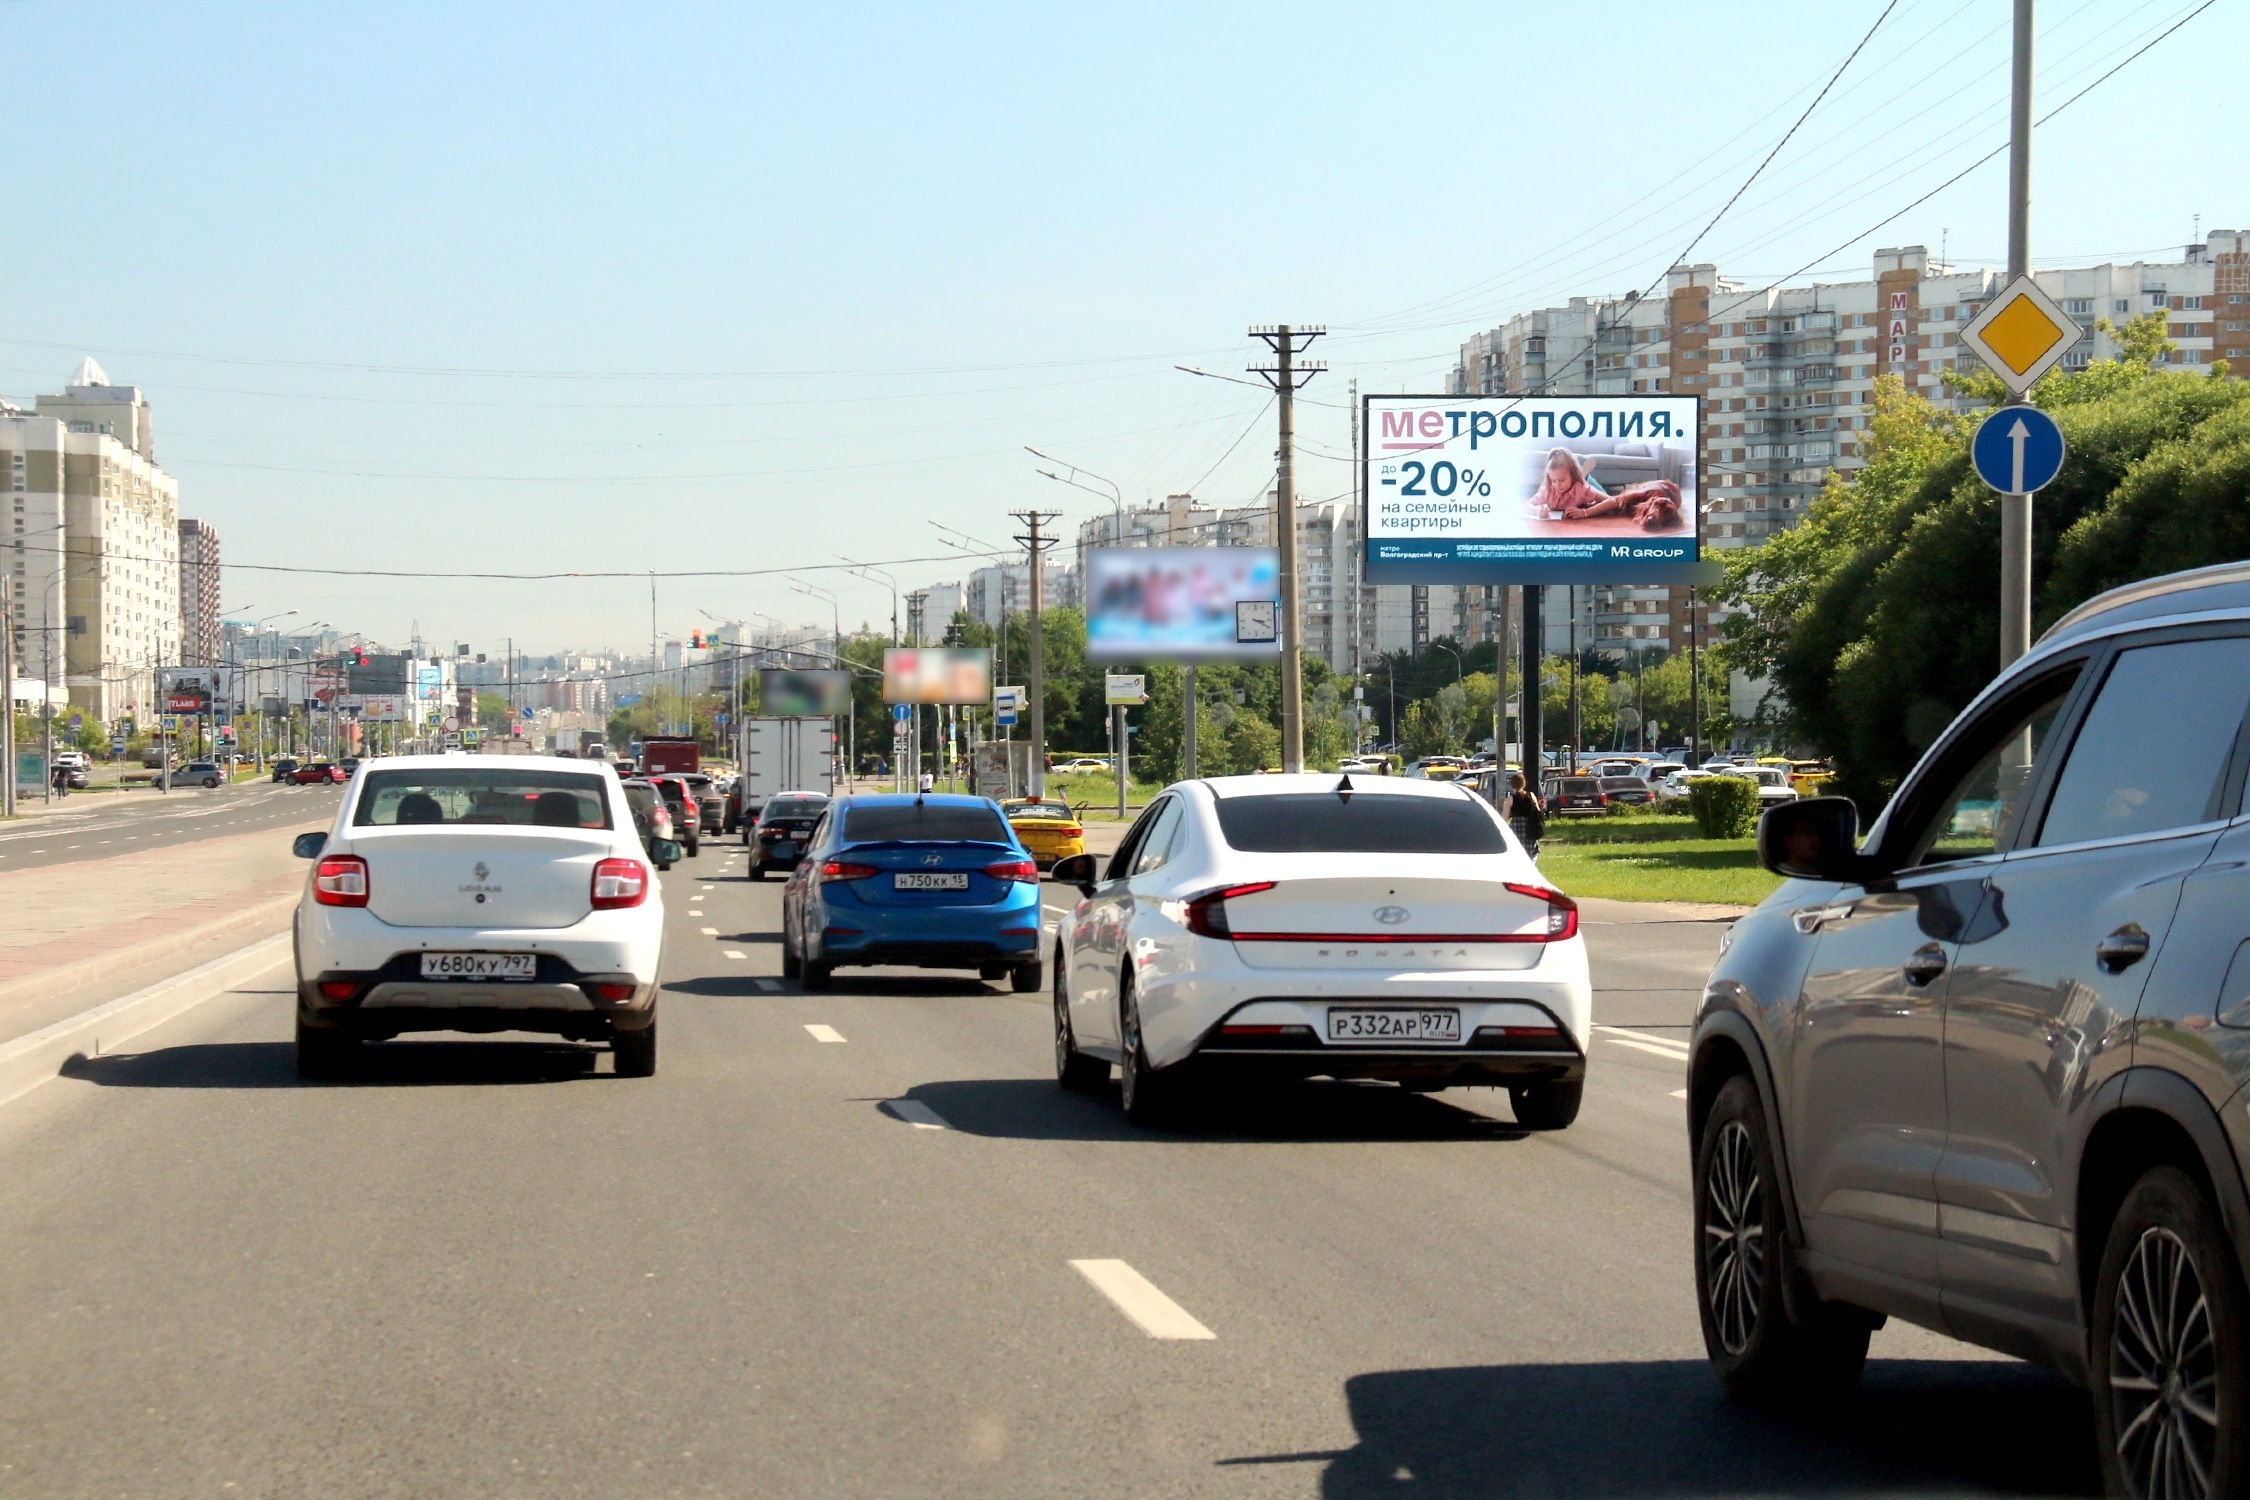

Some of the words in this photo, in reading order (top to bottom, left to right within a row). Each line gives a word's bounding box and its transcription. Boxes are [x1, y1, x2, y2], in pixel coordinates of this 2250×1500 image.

[1382, 410, 1684, 451] метрополия.
[1381, 465, 1397, 475] до
[1381, 460, 1491, 497] -20%
[1381, 502, 1401, 514] на
[1405, 498, 1491, 514] семейные
[1381, 516, 1462, 532] квартиры
[1611, 546, 1630, 557] MR
[1633, 549, 1684, 558] GROUP
[952, 874, 963, 884] 15
[1317, 949, 1467, 957] SONATA
[503, 955, 531, 969] 797
[1336, 1014, 1417, 1035] Р332АР
[1421, 1014, 1453, 1030] 977
